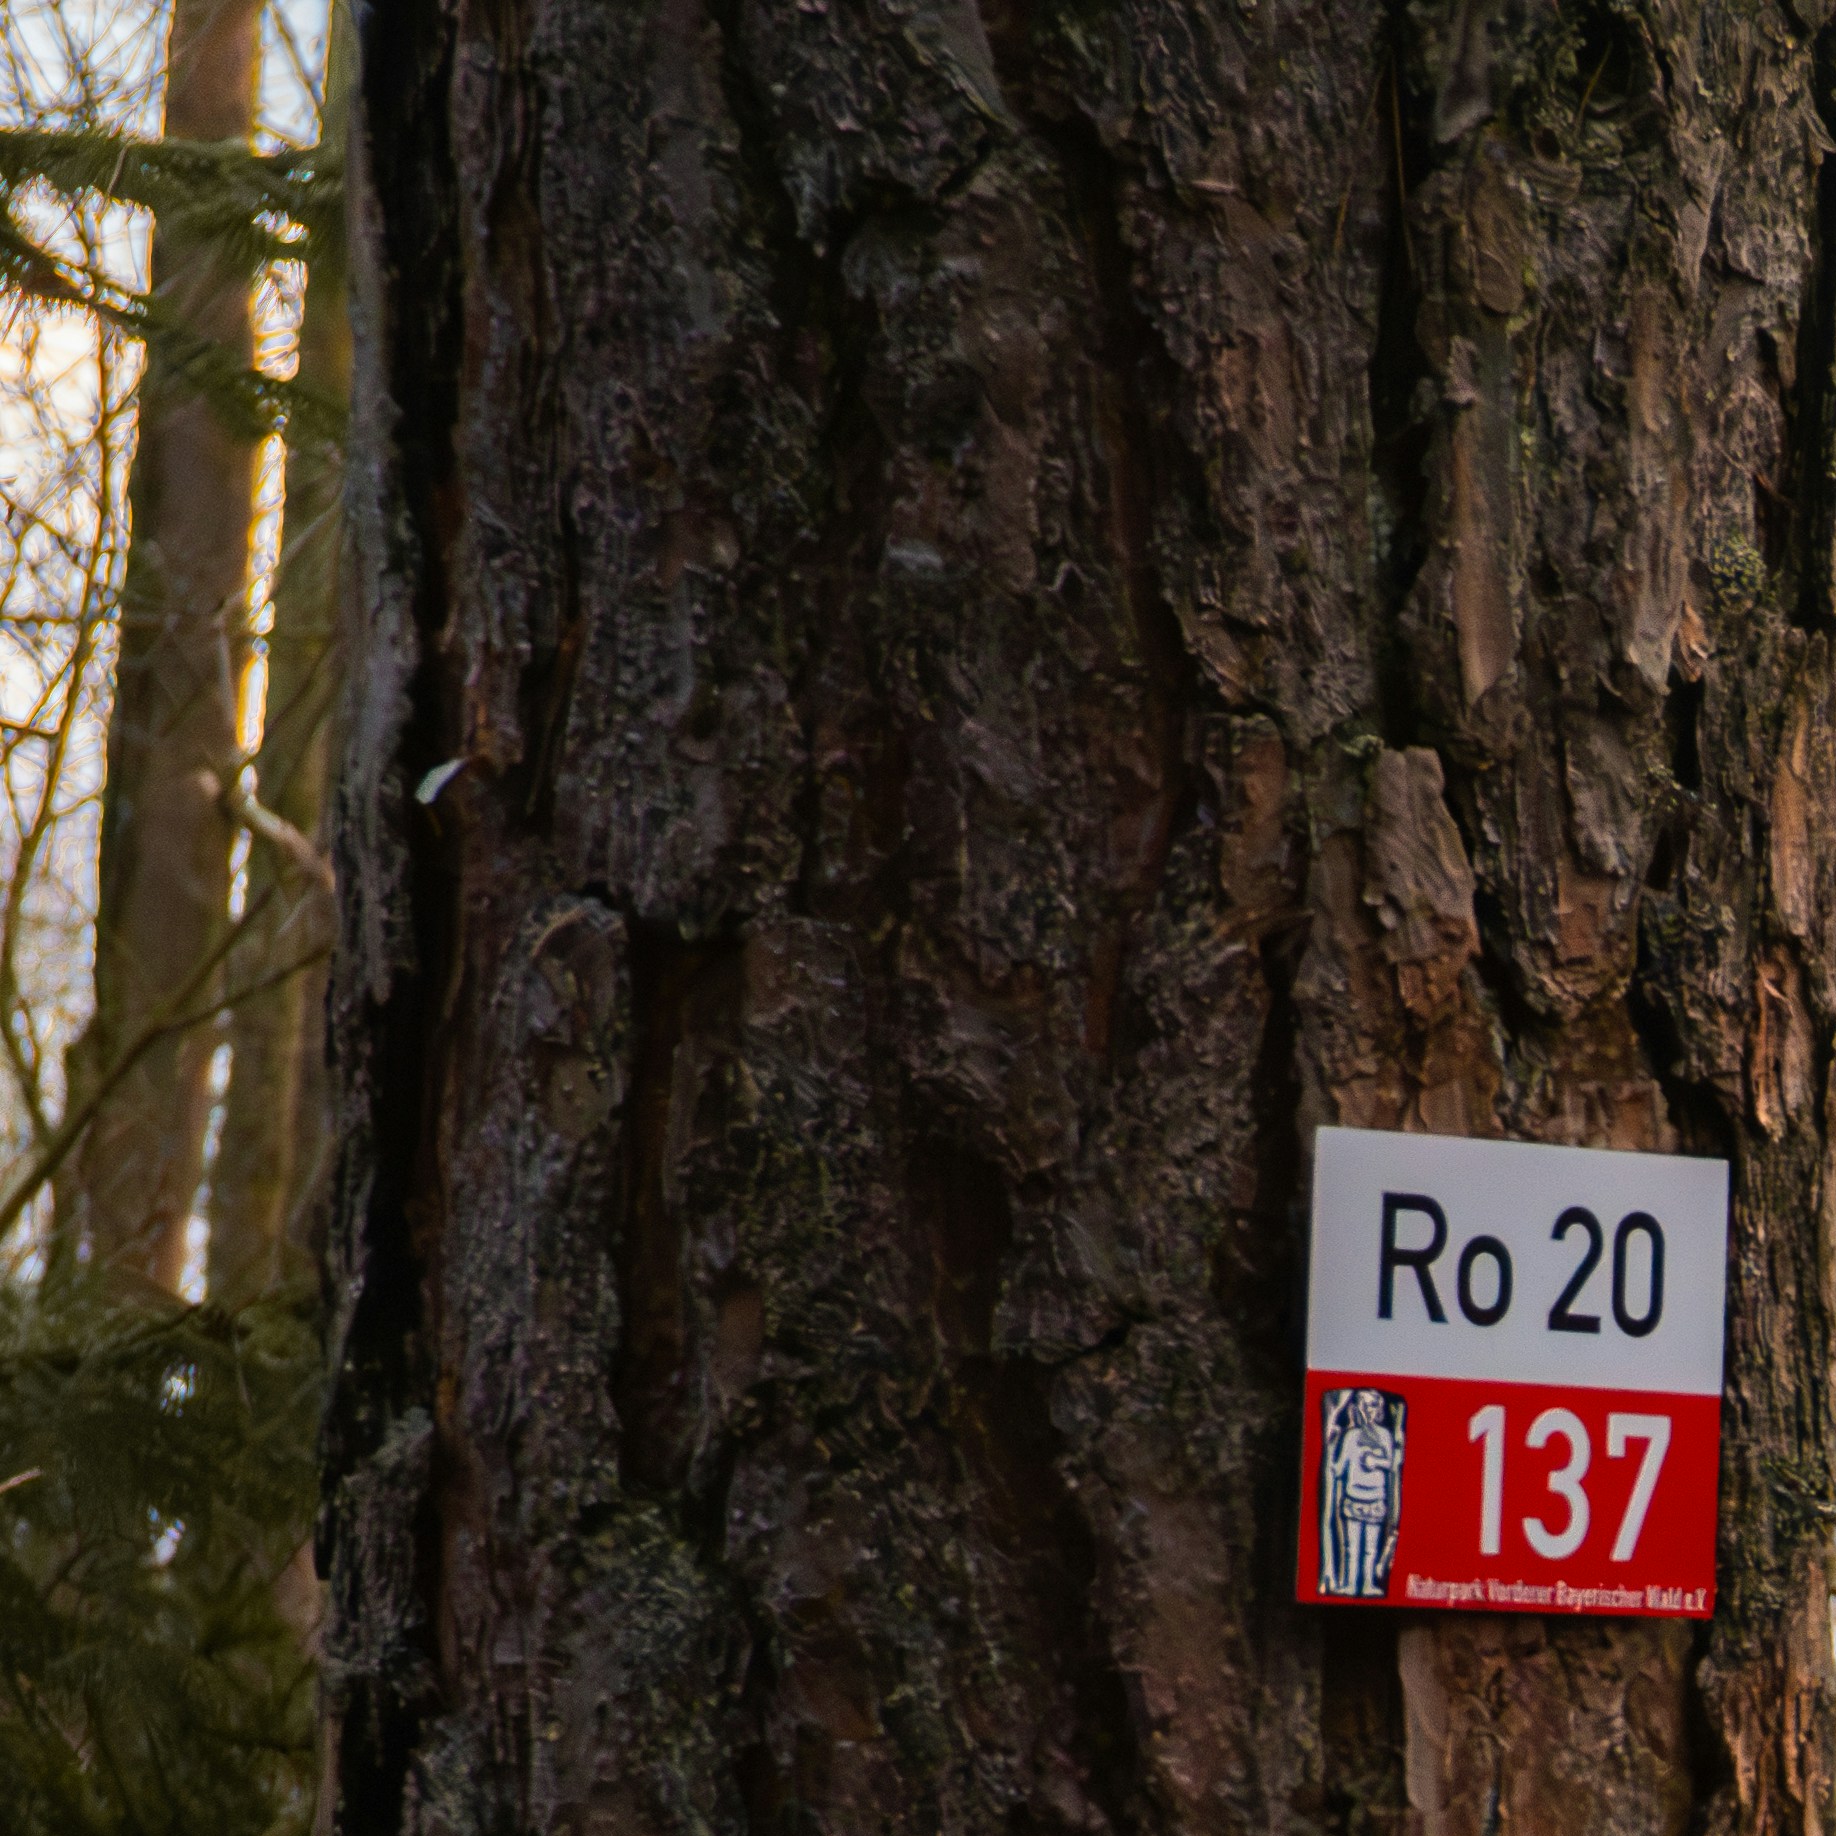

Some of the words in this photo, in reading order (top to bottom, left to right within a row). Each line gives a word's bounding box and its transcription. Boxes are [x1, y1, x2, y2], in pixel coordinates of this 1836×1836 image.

[1376, 1191, 1514, 1327] Ro
[1547, 1205, 1666, 1338] 20
[1467, 1403, 1671, 1563] 137
[1405, 1573, 1486, 1607] Naturpark
